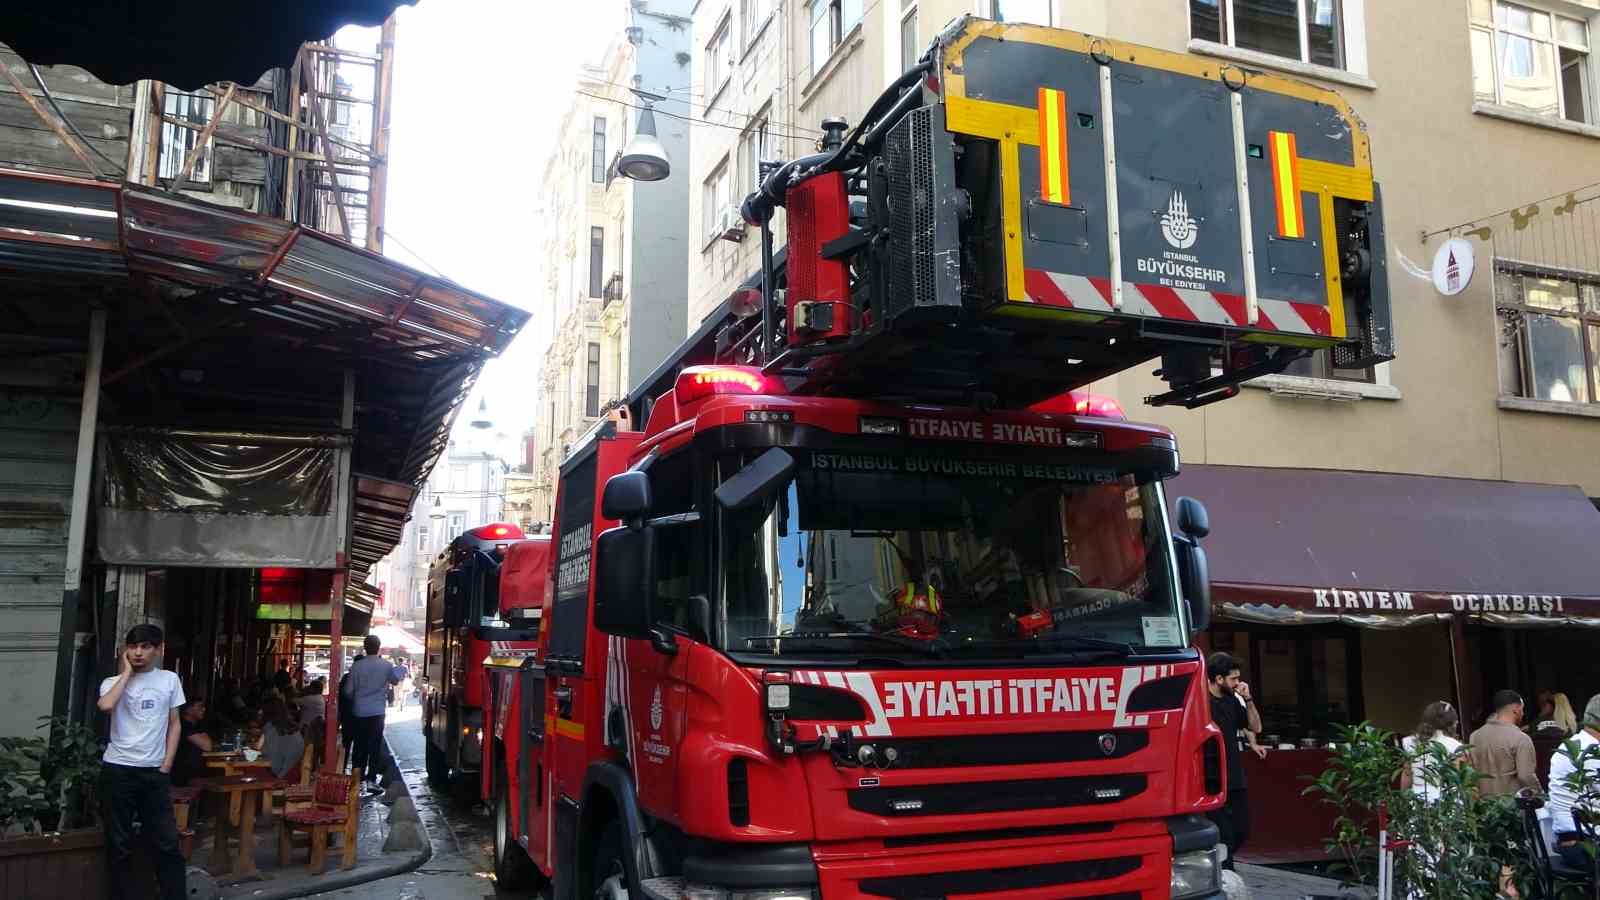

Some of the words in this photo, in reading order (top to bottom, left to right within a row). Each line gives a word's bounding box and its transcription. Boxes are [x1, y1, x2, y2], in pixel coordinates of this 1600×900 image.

[1137, 258, 1226, 283] BÜYÜKŞEHİR
[909, 418, 983, 440] İTFAİYE
[1313, 587, 1415, 610] KİRVEM
[1451, 594, 1564, 615] OCAKBAŞI
[1007, 677, 1117, 714] İTFAİYE
